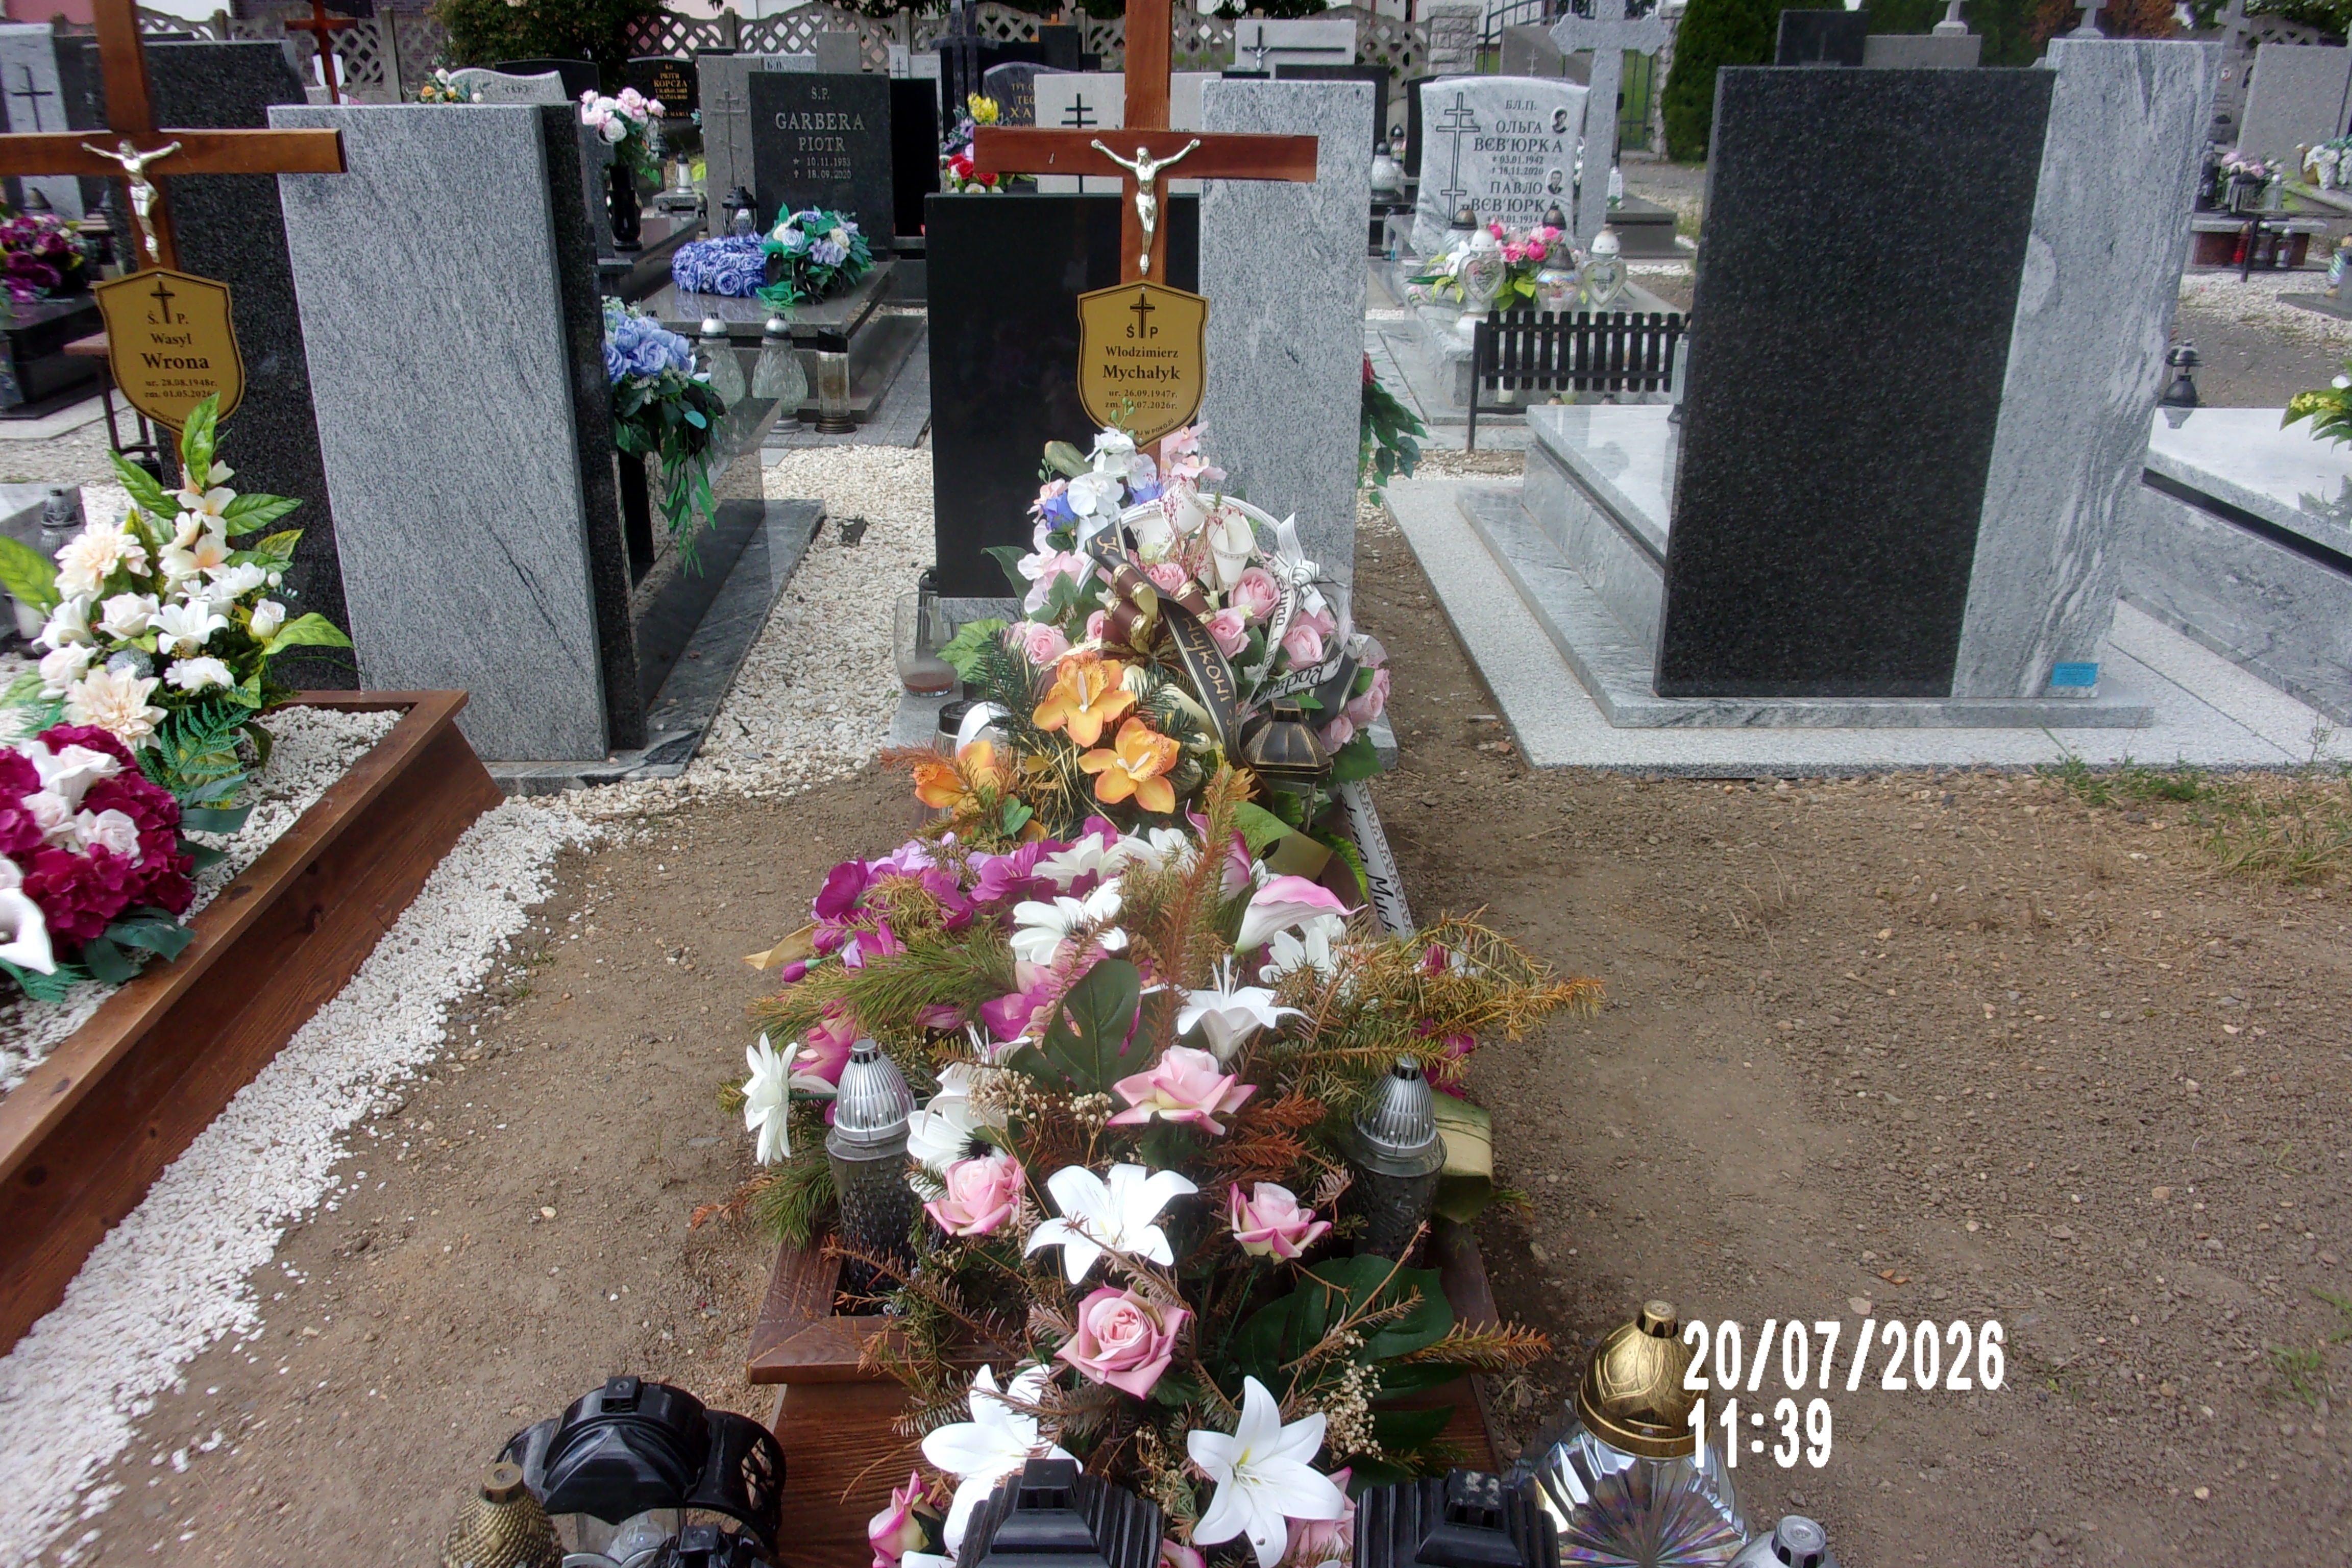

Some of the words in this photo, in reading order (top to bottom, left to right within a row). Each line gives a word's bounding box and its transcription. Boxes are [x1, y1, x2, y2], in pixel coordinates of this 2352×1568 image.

[653, 79, 688, 87] KOPCZA
[775, 112, 865, 130] GARBERA
[1496, 120, 1542, 133] ОЛЬГА
[798, 136, 846, 152] PIOTR
[1500, 155, 1544, 164] 03.01.1942
[1490, 181, 1542, 194] ПАВЛО
[1150, 327, 1158, 339] P
[151, 333, 192, 348] Wasyl
[140, 353, 210, 369] Wrona
[1124, 389, 1178, 398] 26.09.1947r.
[1123, 401, 1178, 409] .07.2026r.
